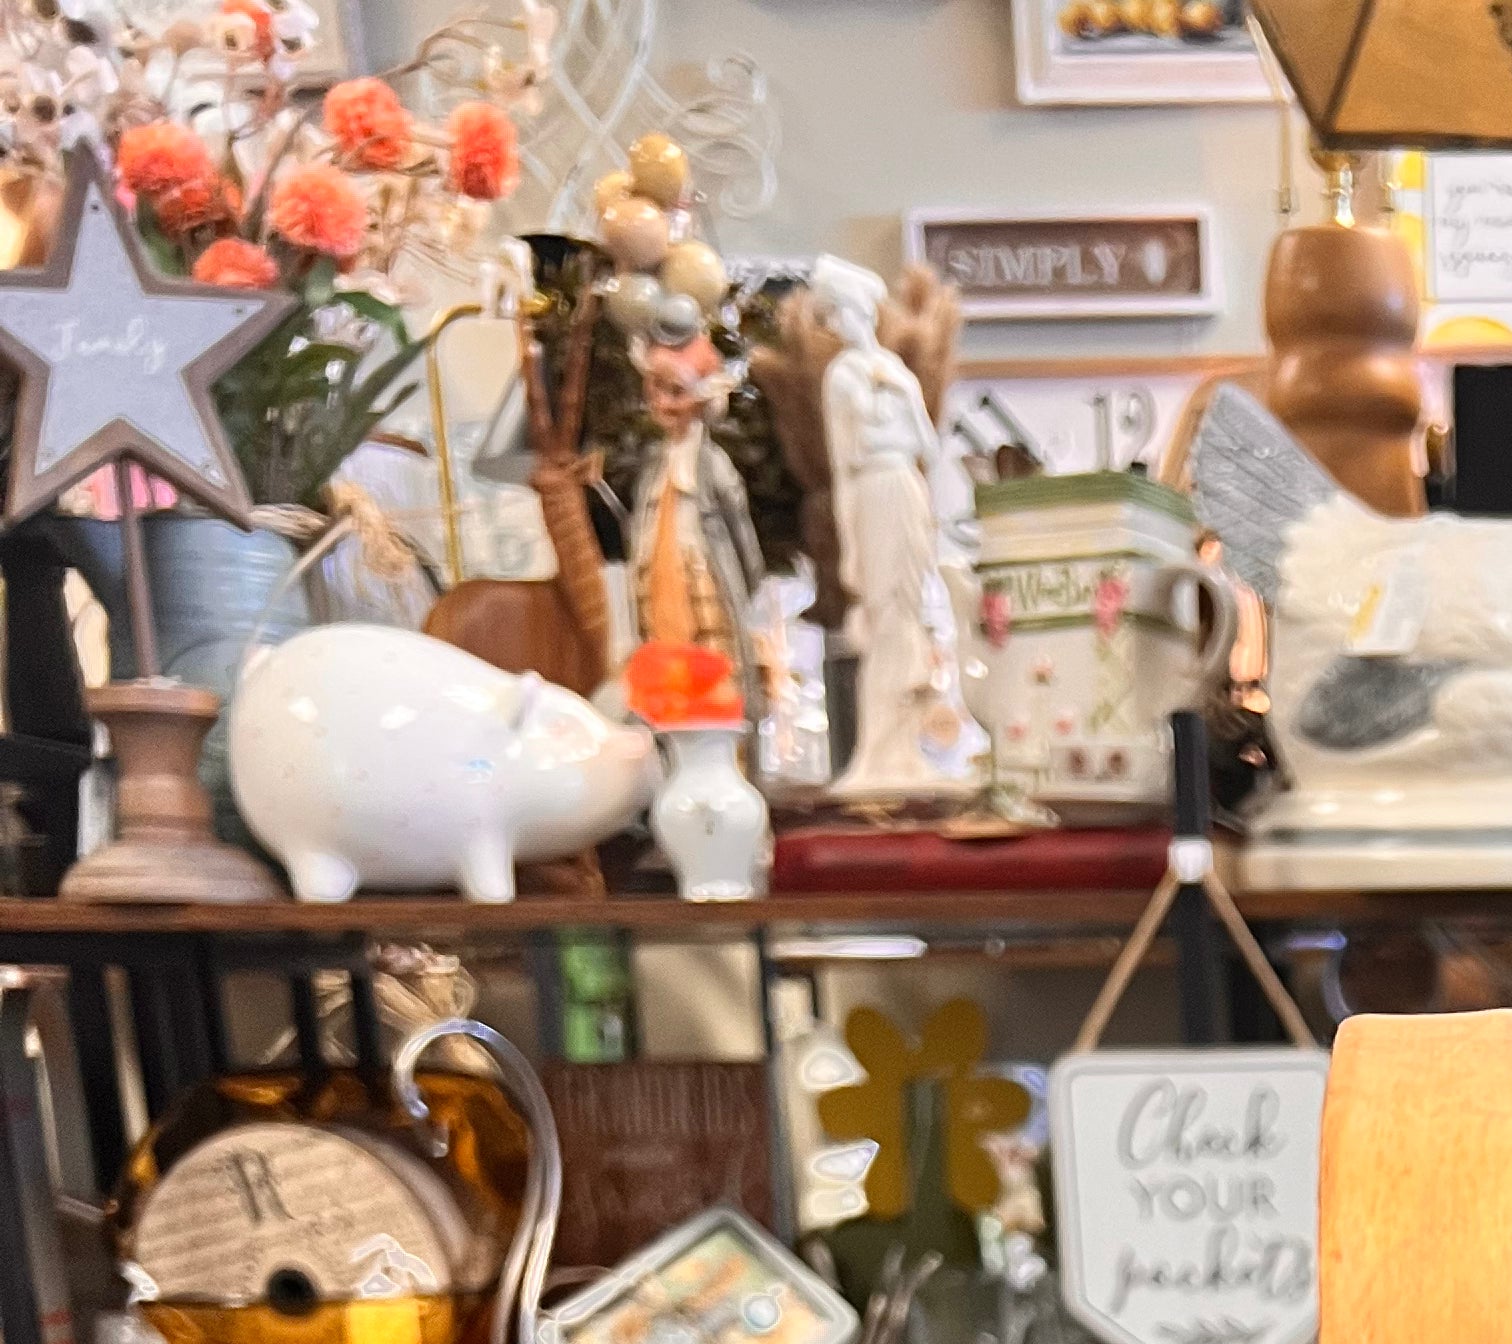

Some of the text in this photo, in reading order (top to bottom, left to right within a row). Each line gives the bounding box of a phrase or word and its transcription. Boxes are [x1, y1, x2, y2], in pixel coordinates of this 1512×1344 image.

[949, 238, 1128, 287] SIMPLY
[1117, 1076, 1290, 1171] Check
[1127, 1172, 1281, 1223] YOUR
